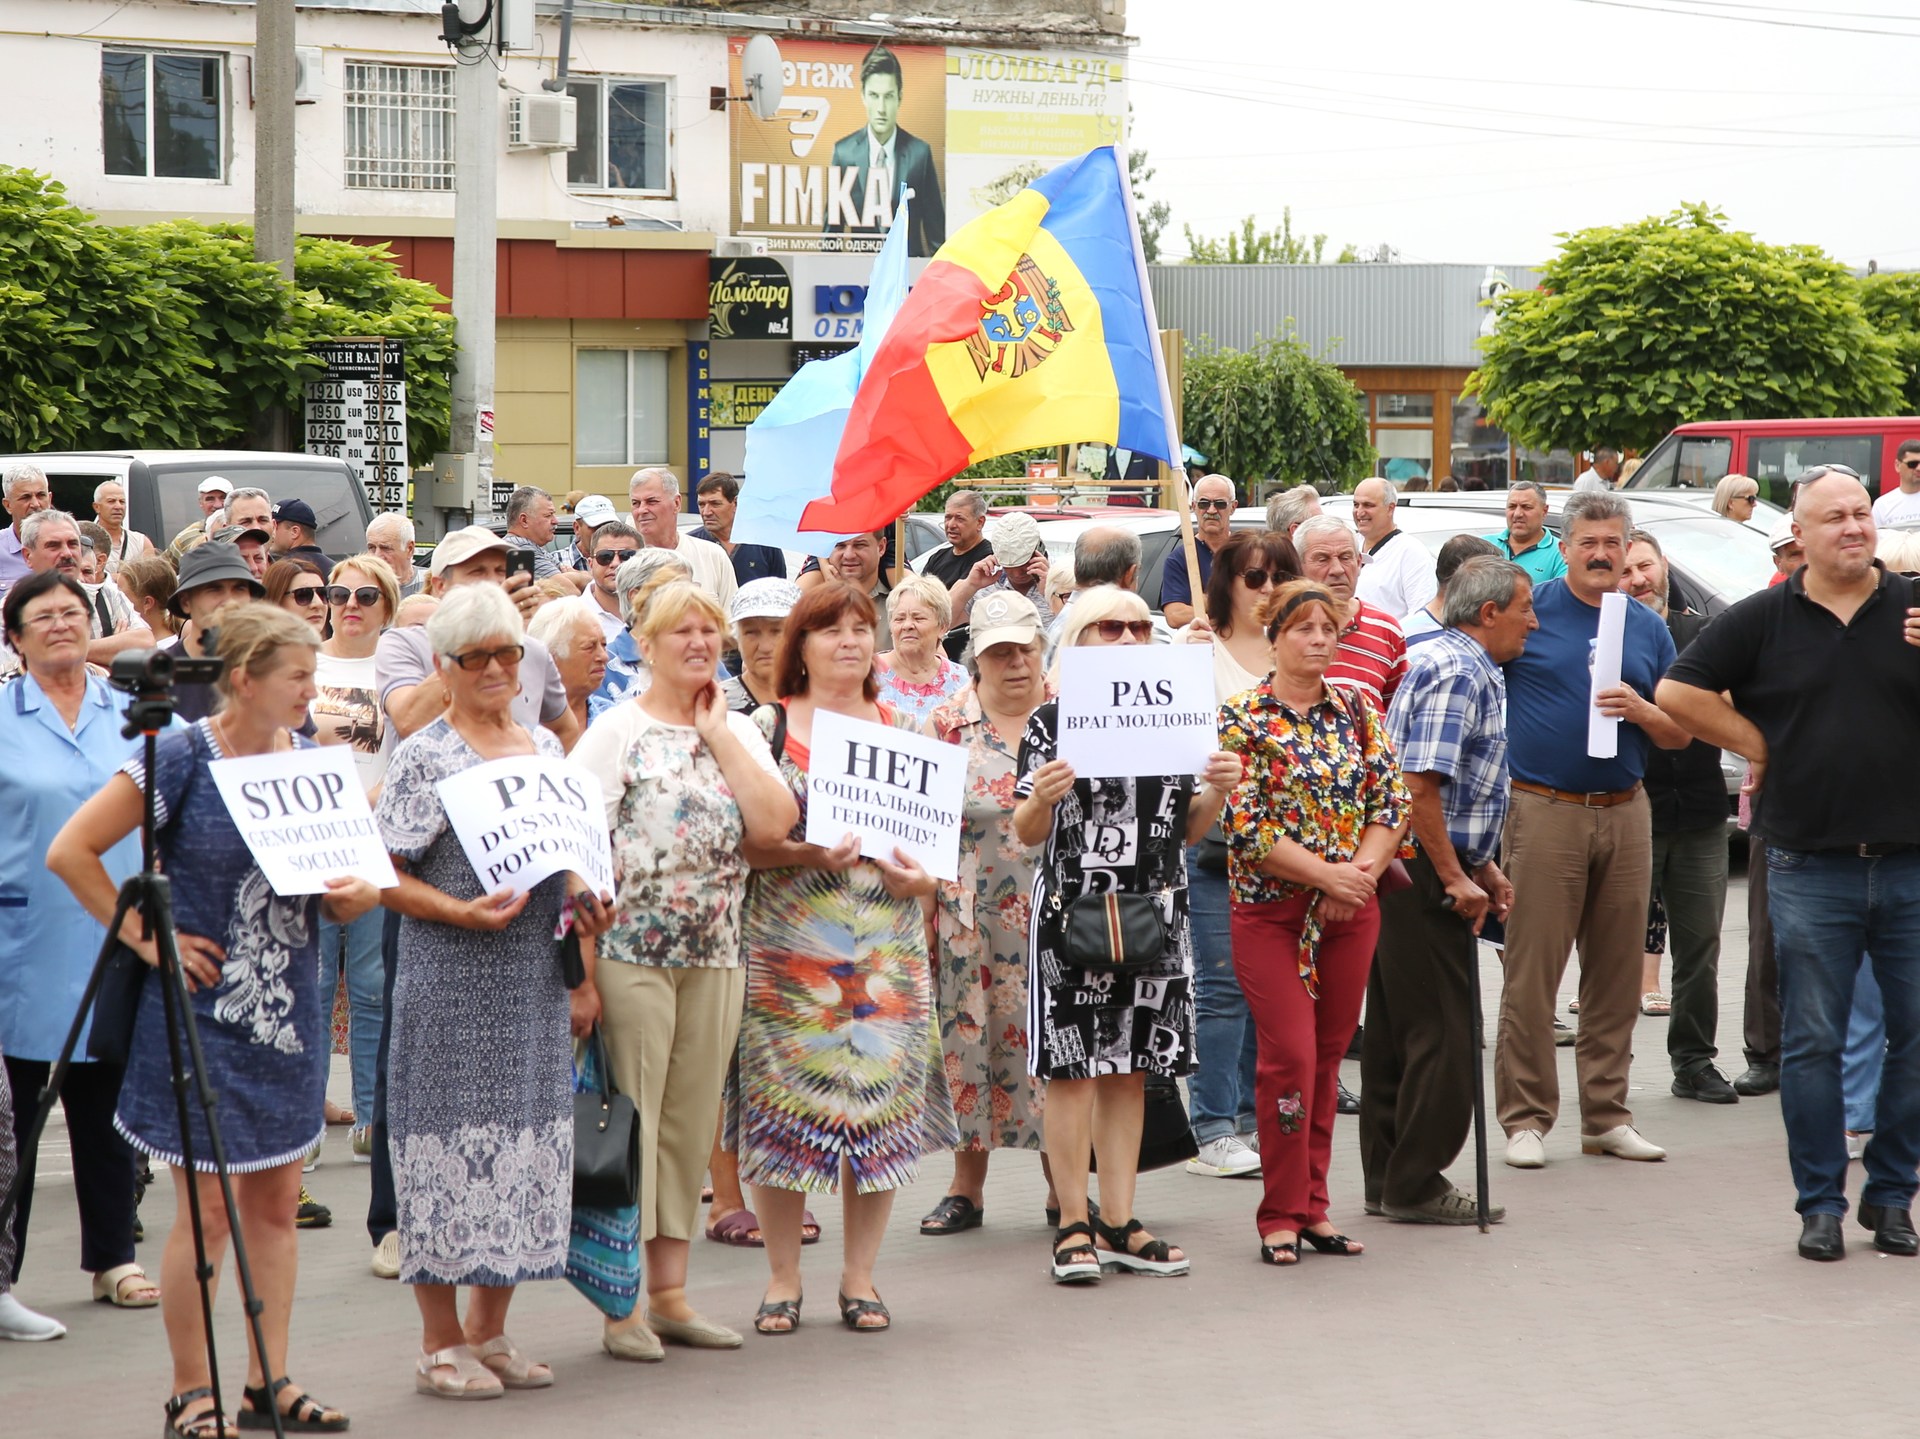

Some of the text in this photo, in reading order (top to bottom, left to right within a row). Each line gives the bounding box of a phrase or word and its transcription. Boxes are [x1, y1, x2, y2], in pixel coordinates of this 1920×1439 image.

[960, 54, 1108, 92] ЛОМБАРД
[973, 89, 1108, 107] НУЖНЫ ДЕНЬГИ?
[741, 163, 893, 226] FIMKA
[791, 238, 843, 250] МУЖСКОЙ
[846, 240, 886, 252] ОДЕЖД
[710, 280, 789, 308] Ломбард
[310, 384, 398, 400] 1920 USD 1936
[735, 387, 782, 405] ДЕНЬ
[312, 404, 394, 420] 1950 EUR 1972
[736, 406, 764, 422] ЗАЛ
[310, 425, 398, 440] 0250 RUR 0310
[348, 449, 362, 458] ROL
[1110, 680, 1173, 706] PAS
[1066, 712, 1212, 730] ВРАГ МОЛДОВЫ!
[843, 740, 938, 796] НЕТ
[241, 772, 343, 820] STOP
[489, 773, 587, 812] PAS
[813, 778, 958, 828] СОЦИАЛЬНОМУ
[248, 818, 375, 848] GENOCIDULUI
[832, 806, 937, 847] ГЕНОЦИДУ!
[288, 848, 360, 872] SOCIAL!
[486, 838, 610, 886] POPORULUI!
[1074, 991, 1112, 1005] Dior
[1136, 1054, 1176, 1078] Dior
